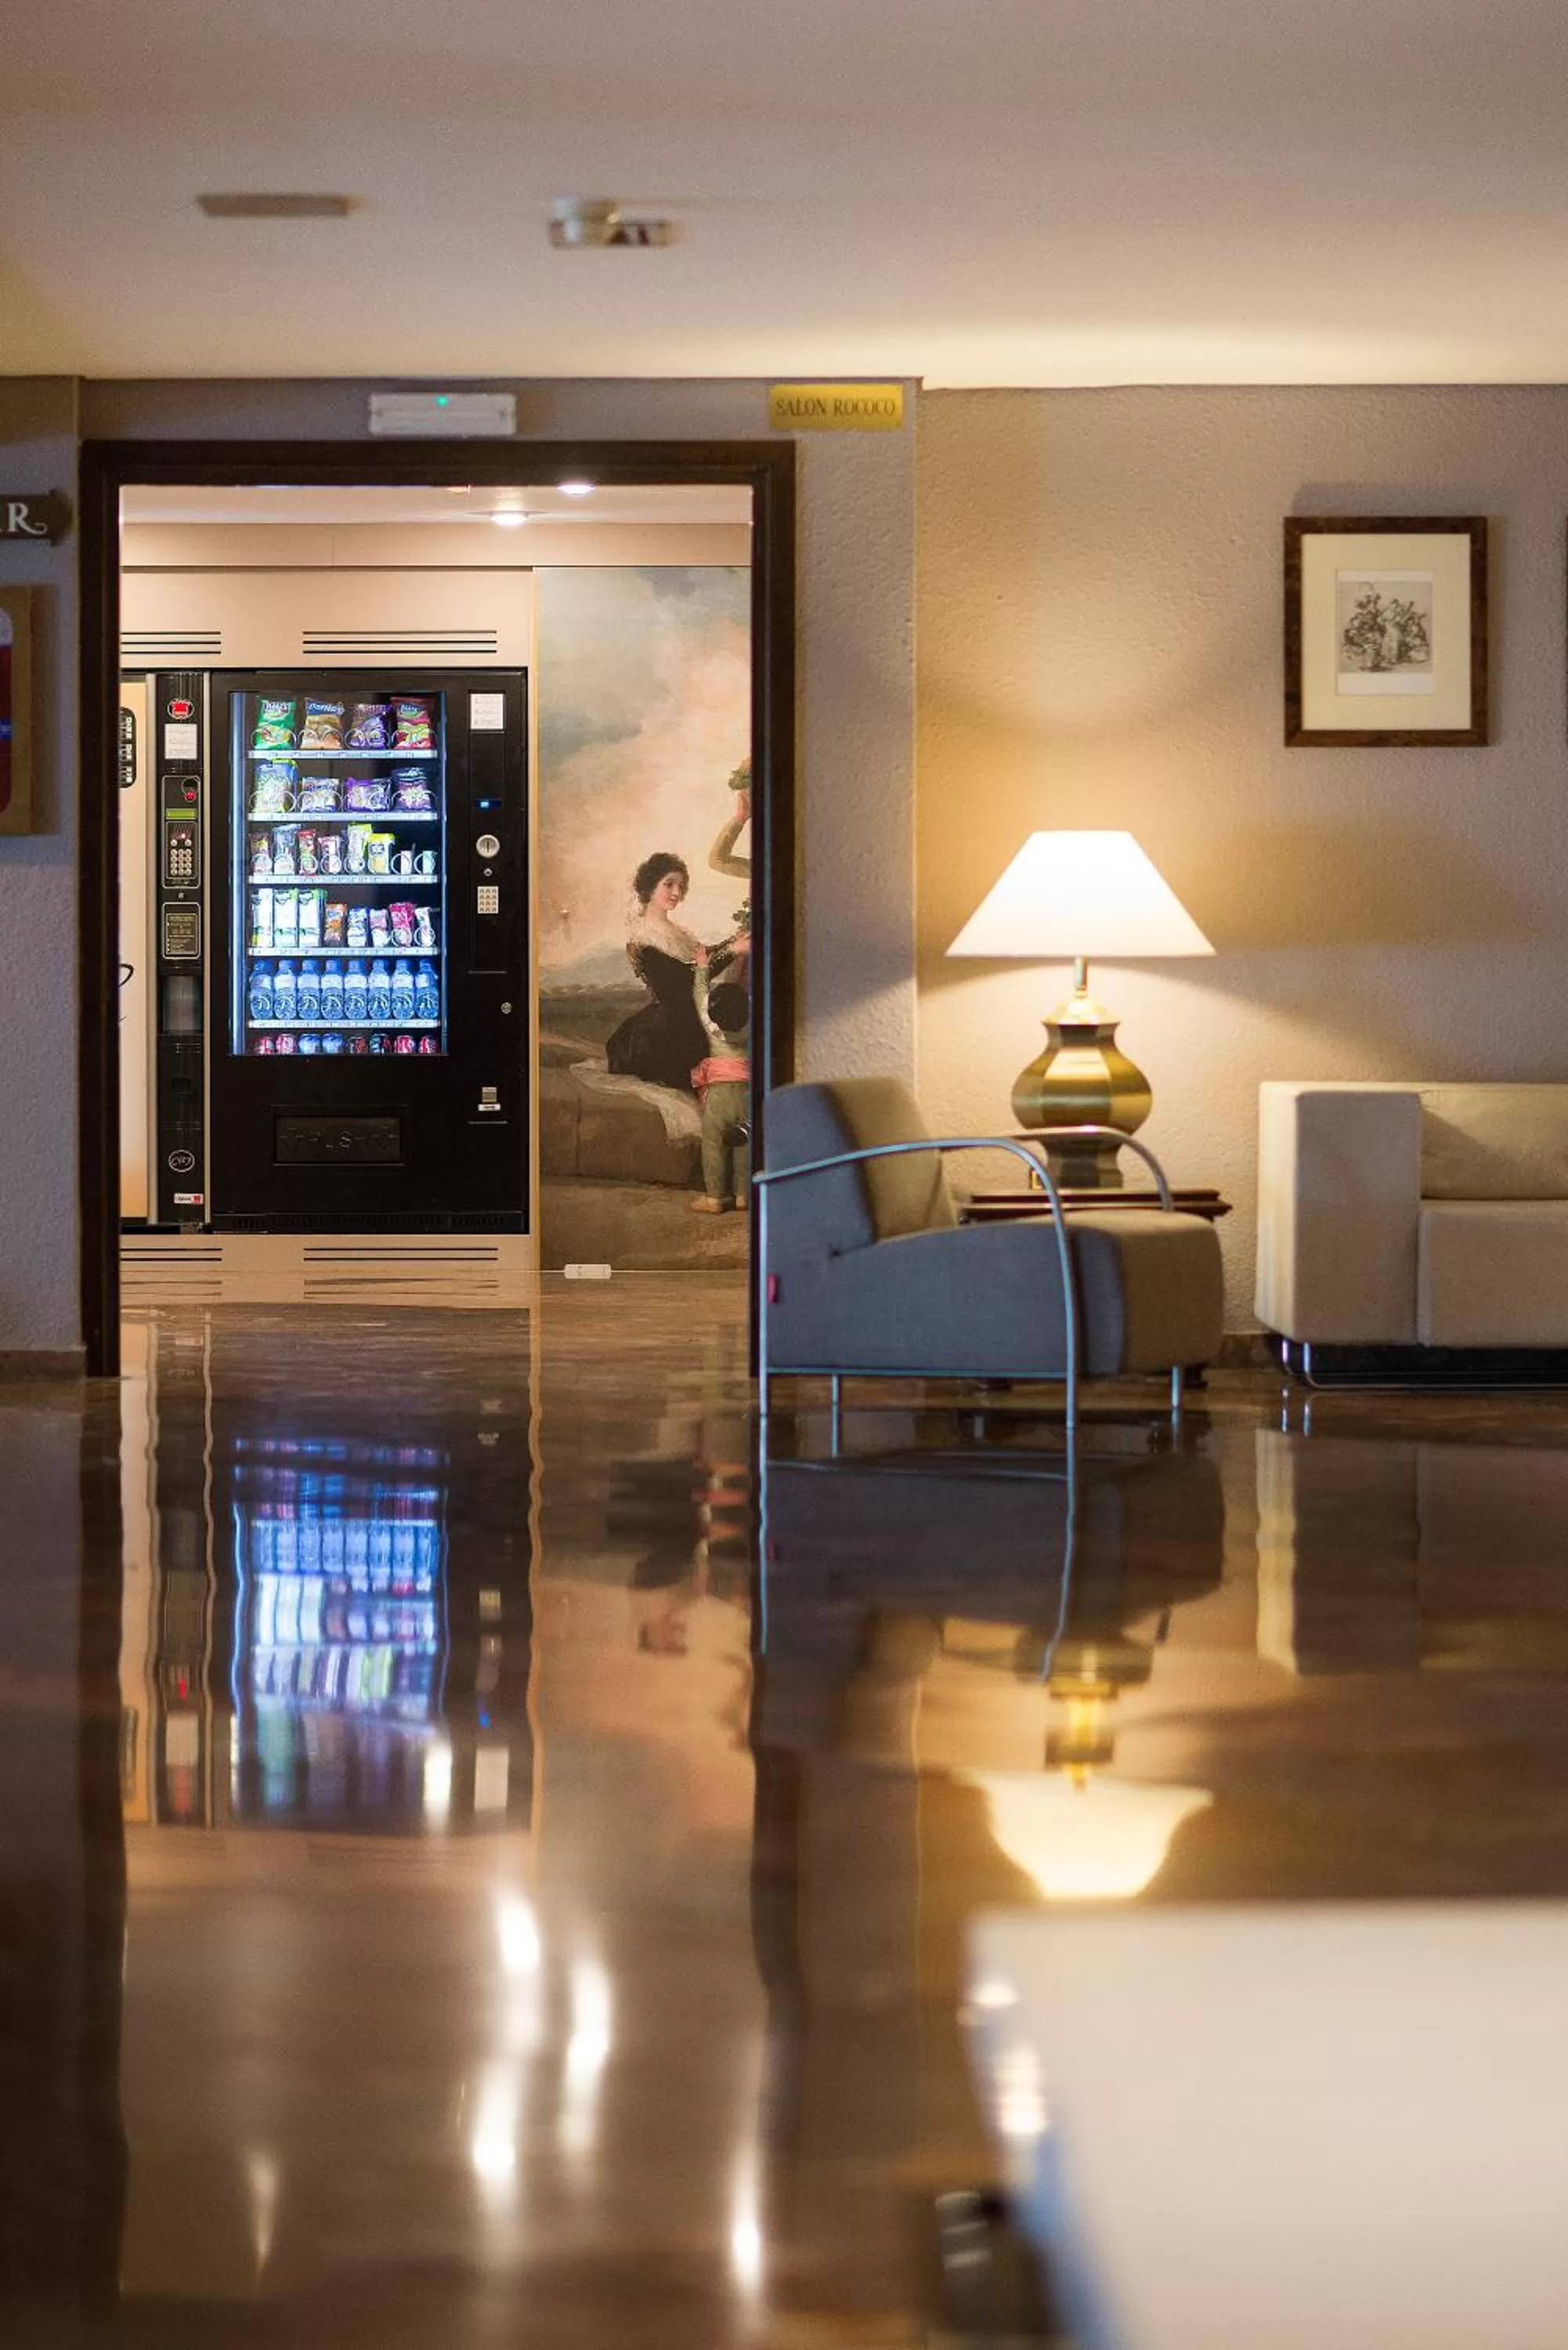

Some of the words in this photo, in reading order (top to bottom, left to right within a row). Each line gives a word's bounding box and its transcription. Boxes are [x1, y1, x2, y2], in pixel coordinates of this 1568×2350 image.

[775, 397, 827, 417] SALON
[833, 399, 896, 417] ROCOCO
[0, 501, 49, 536] R
